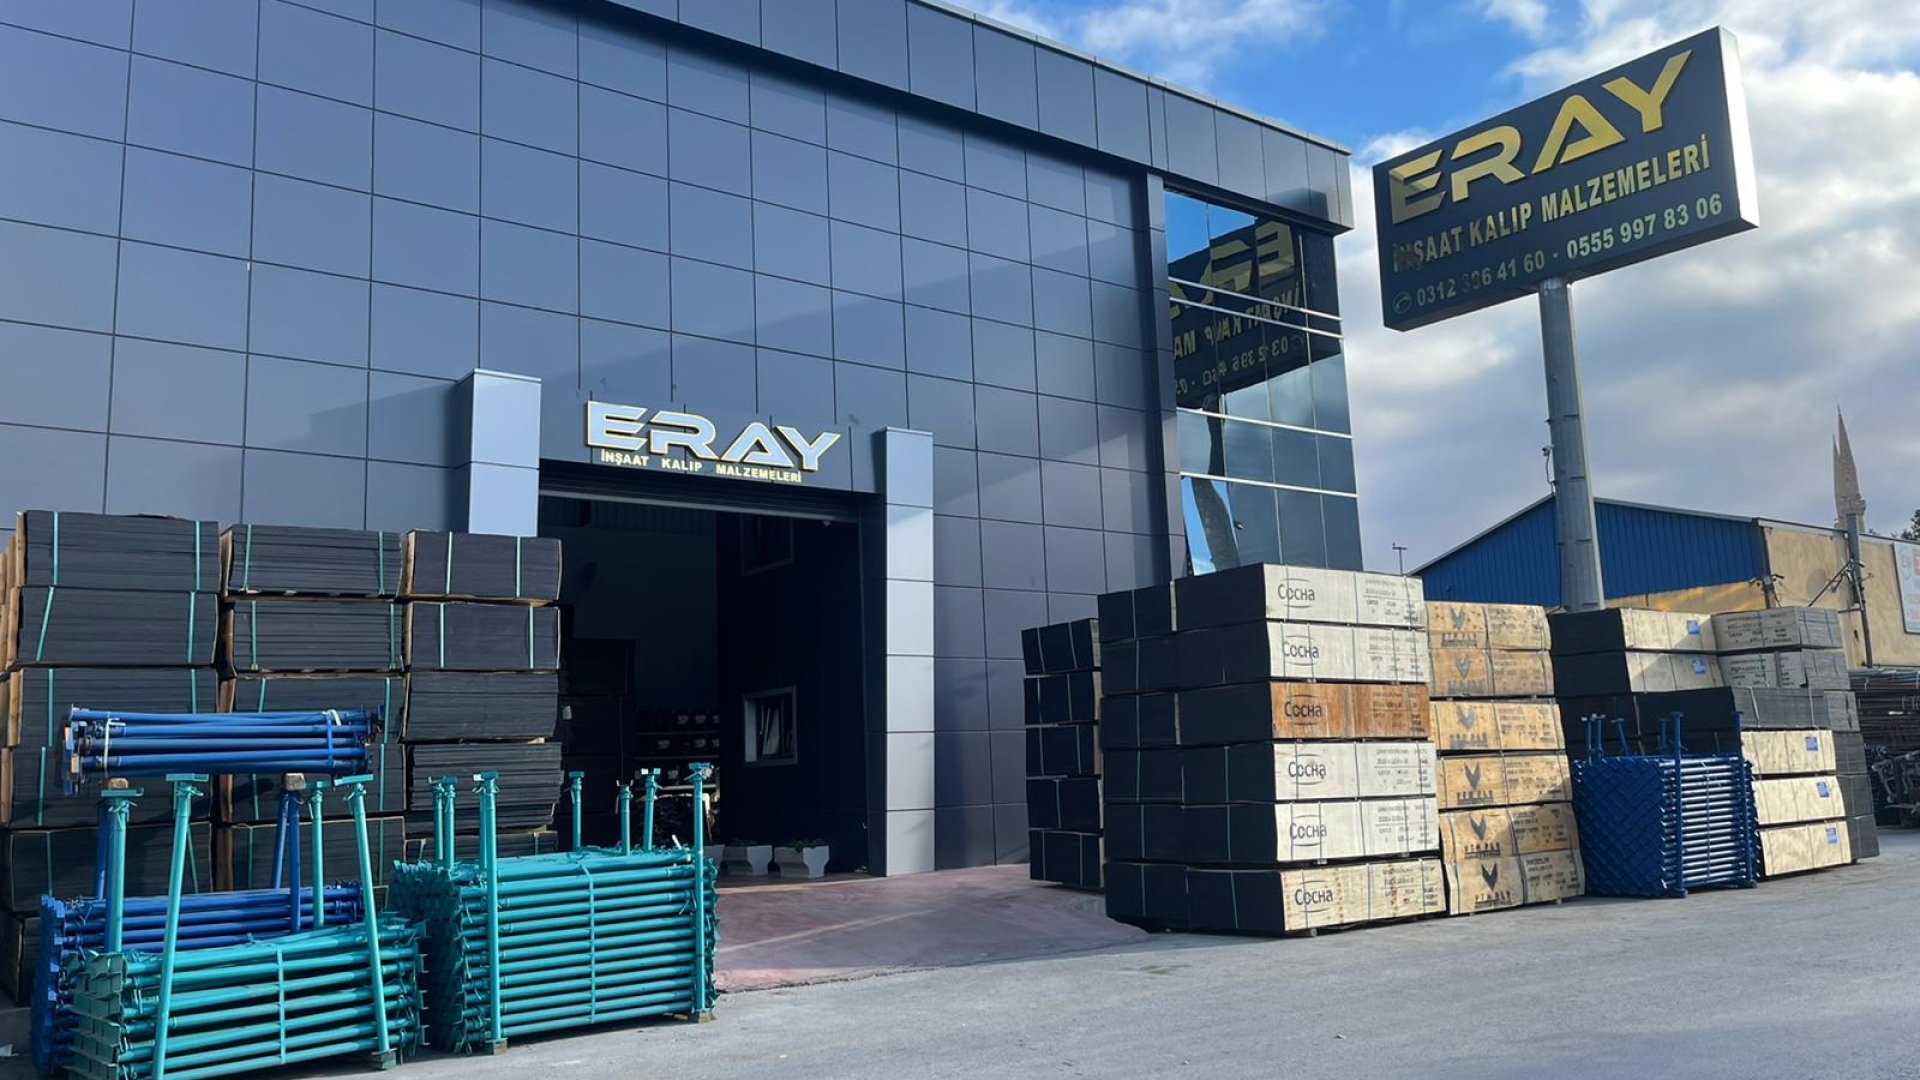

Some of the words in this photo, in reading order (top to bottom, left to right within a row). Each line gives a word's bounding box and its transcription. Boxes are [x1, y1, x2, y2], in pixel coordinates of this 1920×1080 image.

[1389, 49, 1692, 224] ERAY
[1470, 202, 1532, 246] KALIP
[1542, 133, 1710, 222] MALZEMELERİ
[1416, 278, 1458, 307] 0312
[1497, 258, 1517, 281] 41
[1524, 250, 1545, 273] 60
[1566, 227, 1615, 259] 0555
[1619, 213, 1657, 243] 997
[1663, 203, 1689, 229] 83
[1696, 193, 1723, 219] 06
[587, 400, 841, 471] ERAY
[601, 449, 649, 467] İNŞAAT
[661, 458, 703, 472] KALIP
[716, 464, 802, 483] MALZEMELERİ
